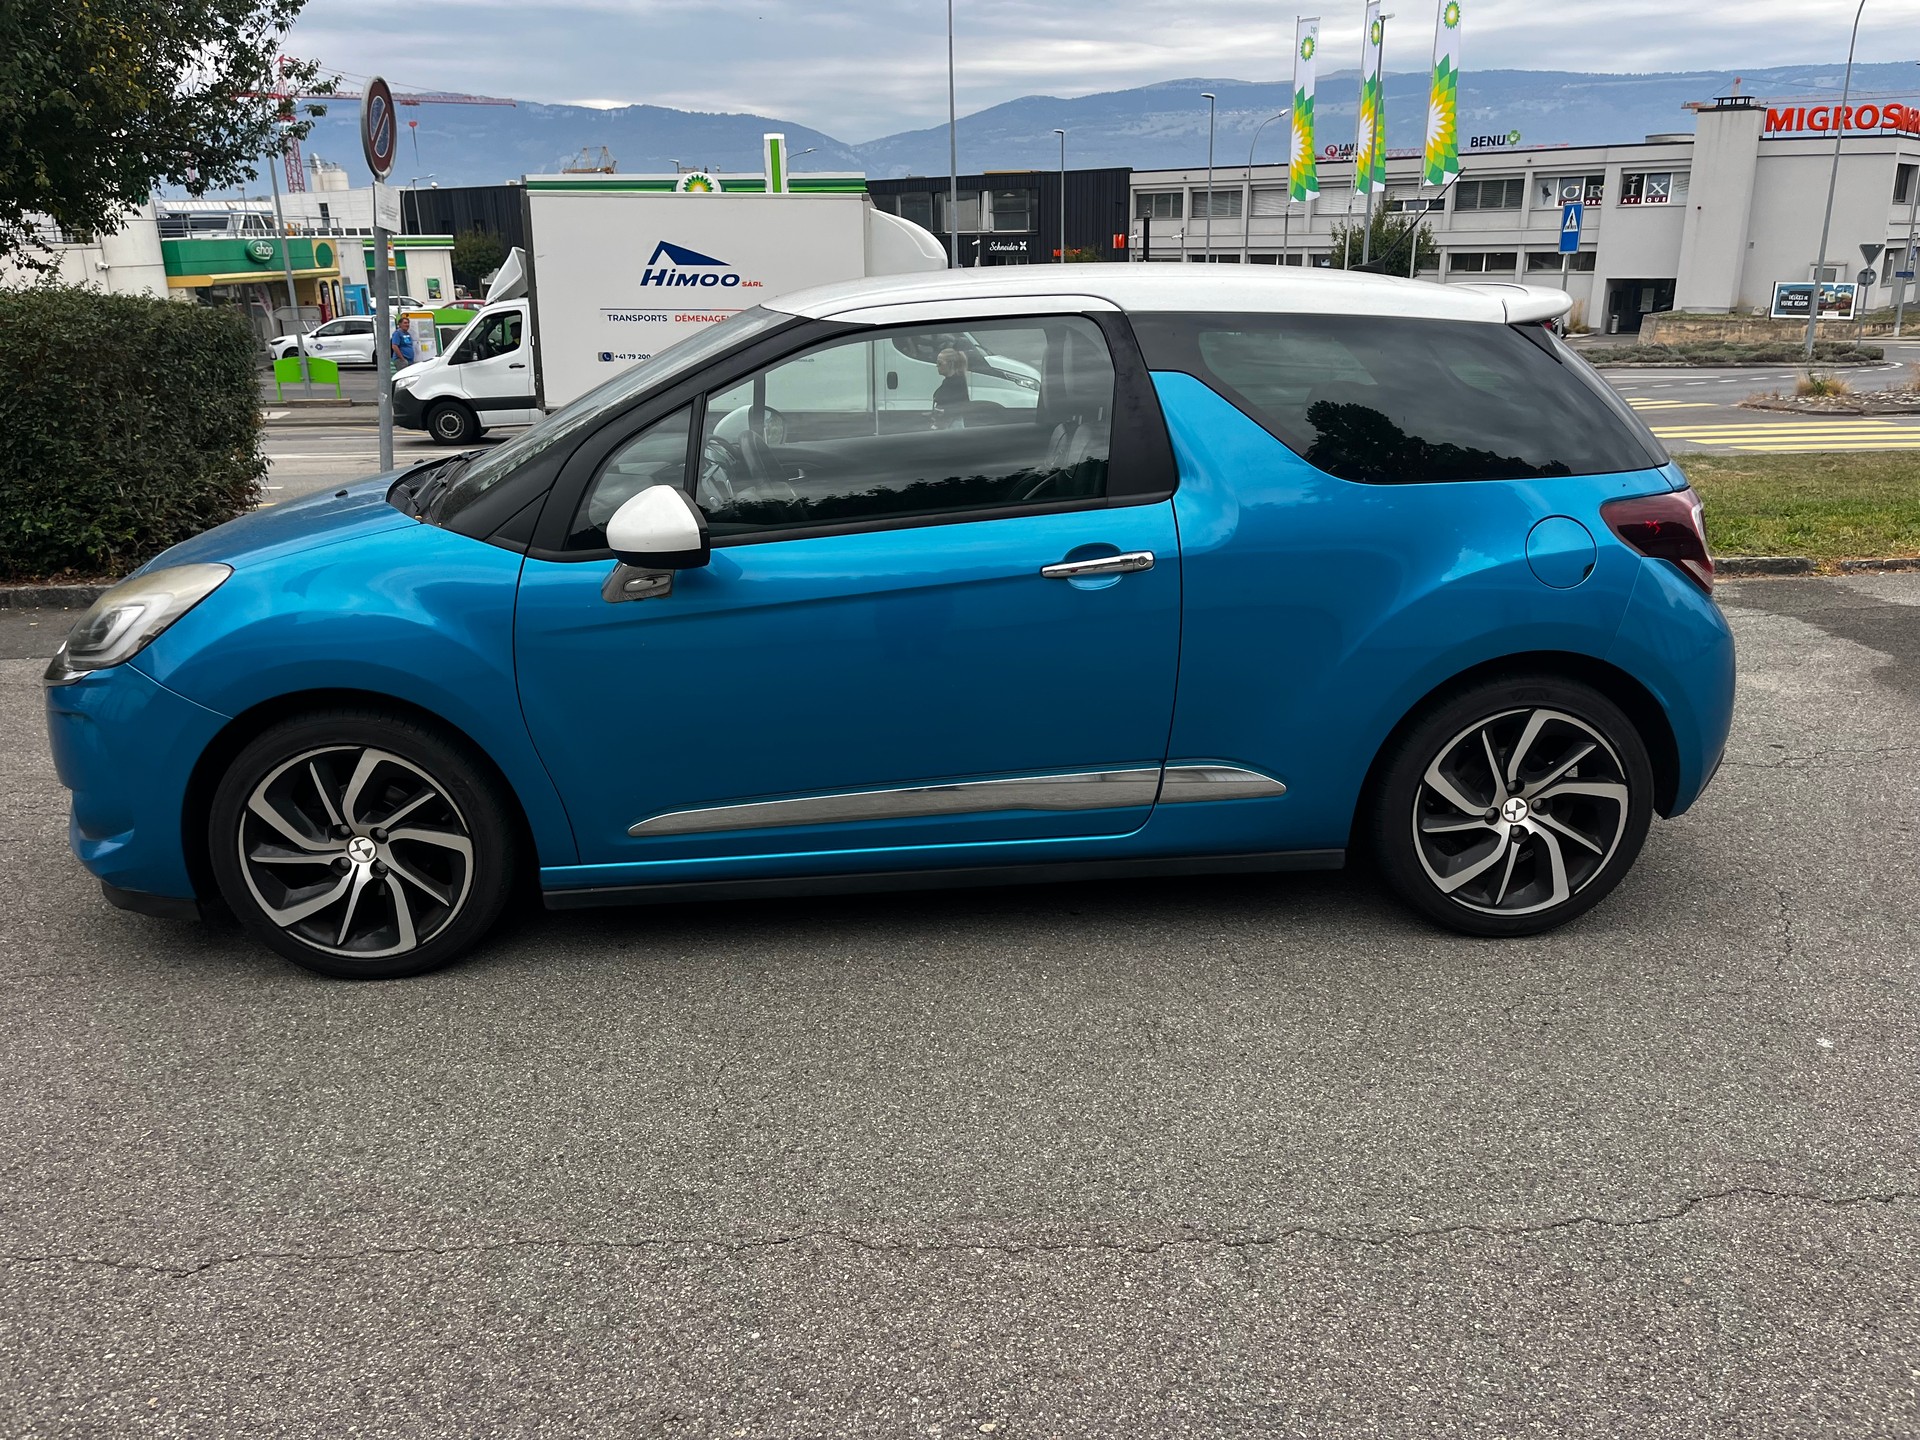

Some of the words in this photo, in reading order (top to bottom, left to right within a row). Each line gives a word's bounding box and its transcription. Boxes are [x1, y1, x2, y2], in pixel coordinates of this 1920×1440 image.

[1765, 103, 1904, 132] MIGROS
[1470, 134, 1506, 147] BENU
[255, 241, 274, 259] shop
[989, 241, 1019, 251] Schneider
[607, 314, 668, 322] TRANSPORTS
[674, 313, 730, 323] DÉMENAGE
